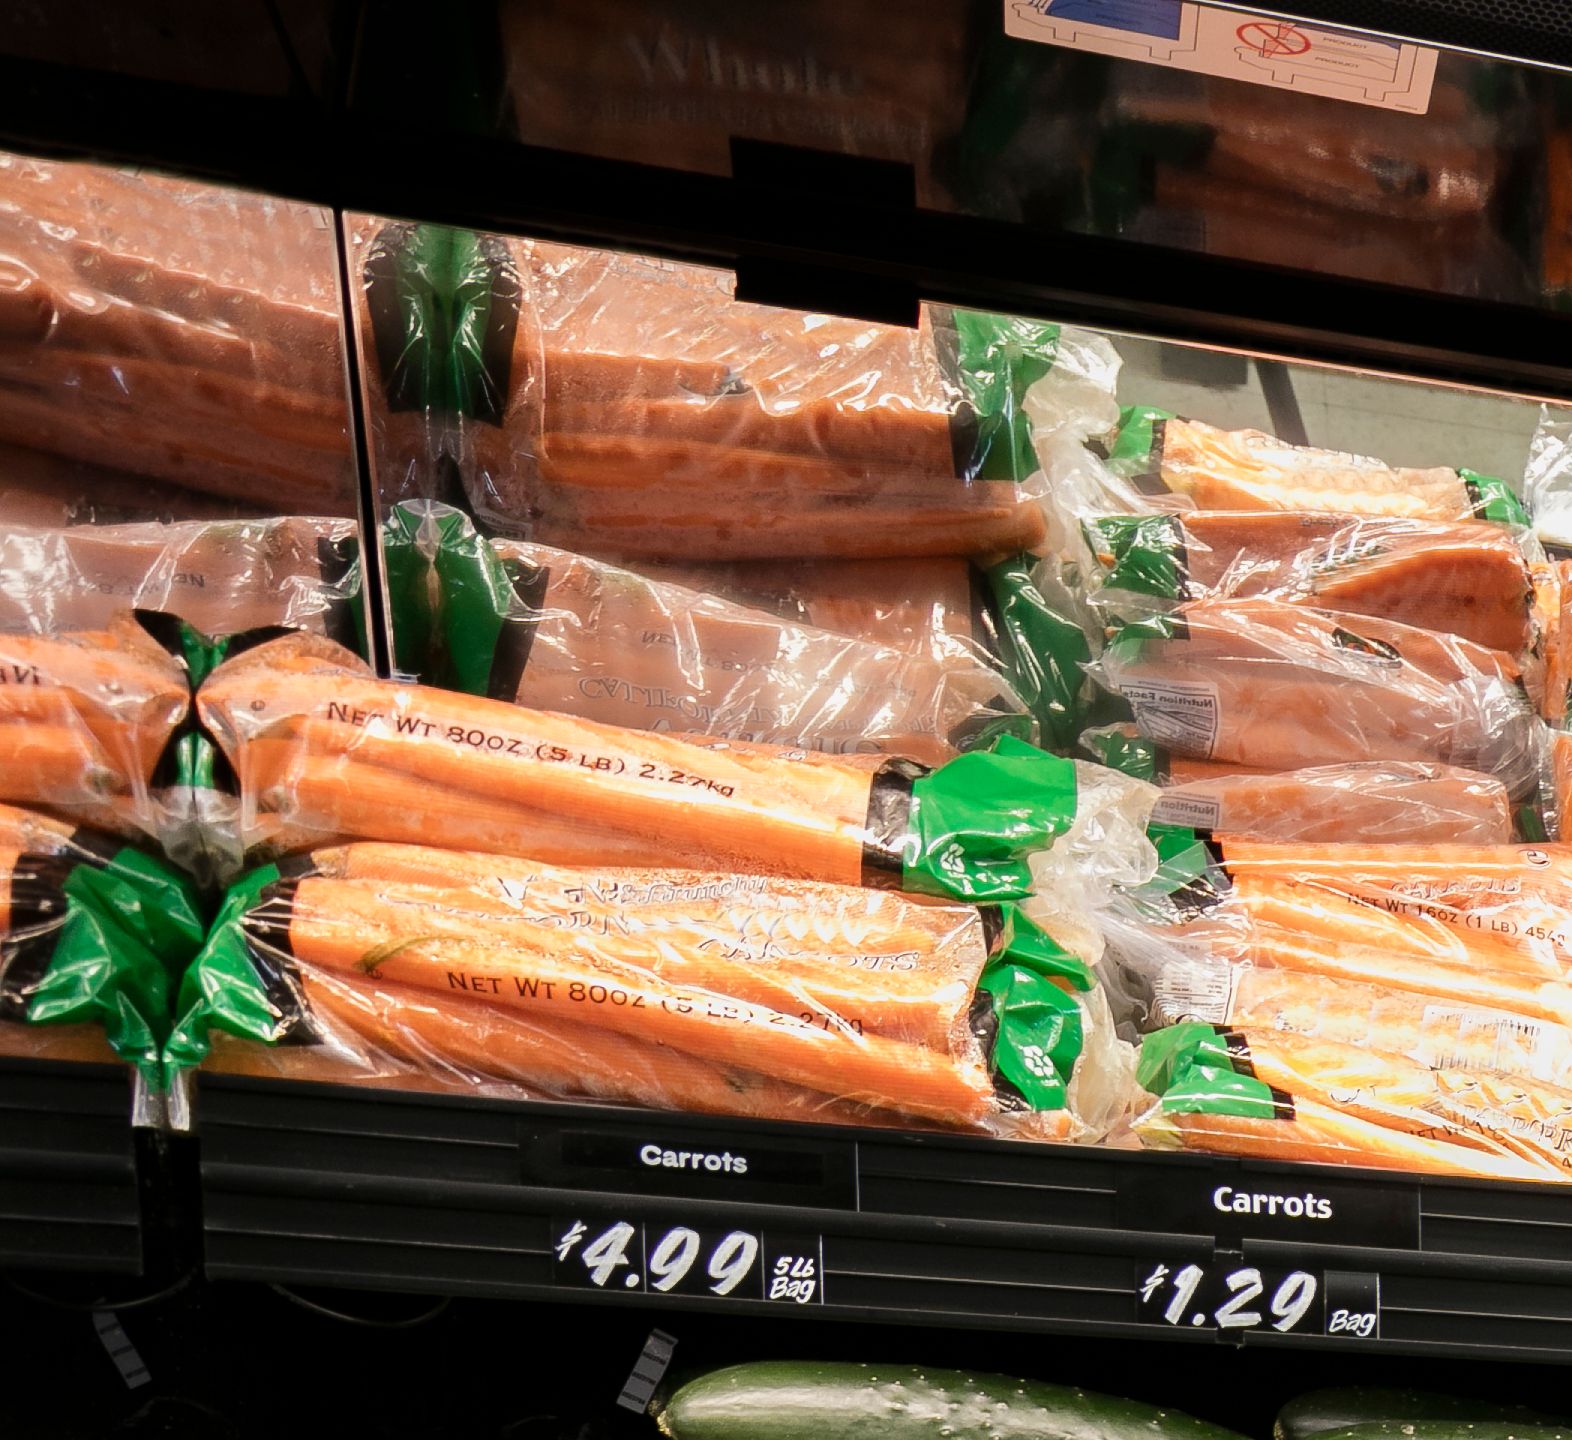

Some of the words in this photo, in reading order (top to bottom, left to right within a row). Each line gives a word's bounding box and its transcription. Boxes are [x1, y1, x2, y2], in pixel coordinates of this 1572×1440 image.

[641, 1145, 748, 1176] Carrots
[1214, 1188, 1331, 1221] Carrots
[555, 1219, 758, 1295] $4.99
[770, 1277, 815, 1305] Bag
[1141, 1262, 1317, 1333] $1.29
[1330, 1309, 1376, 1338] Bag
